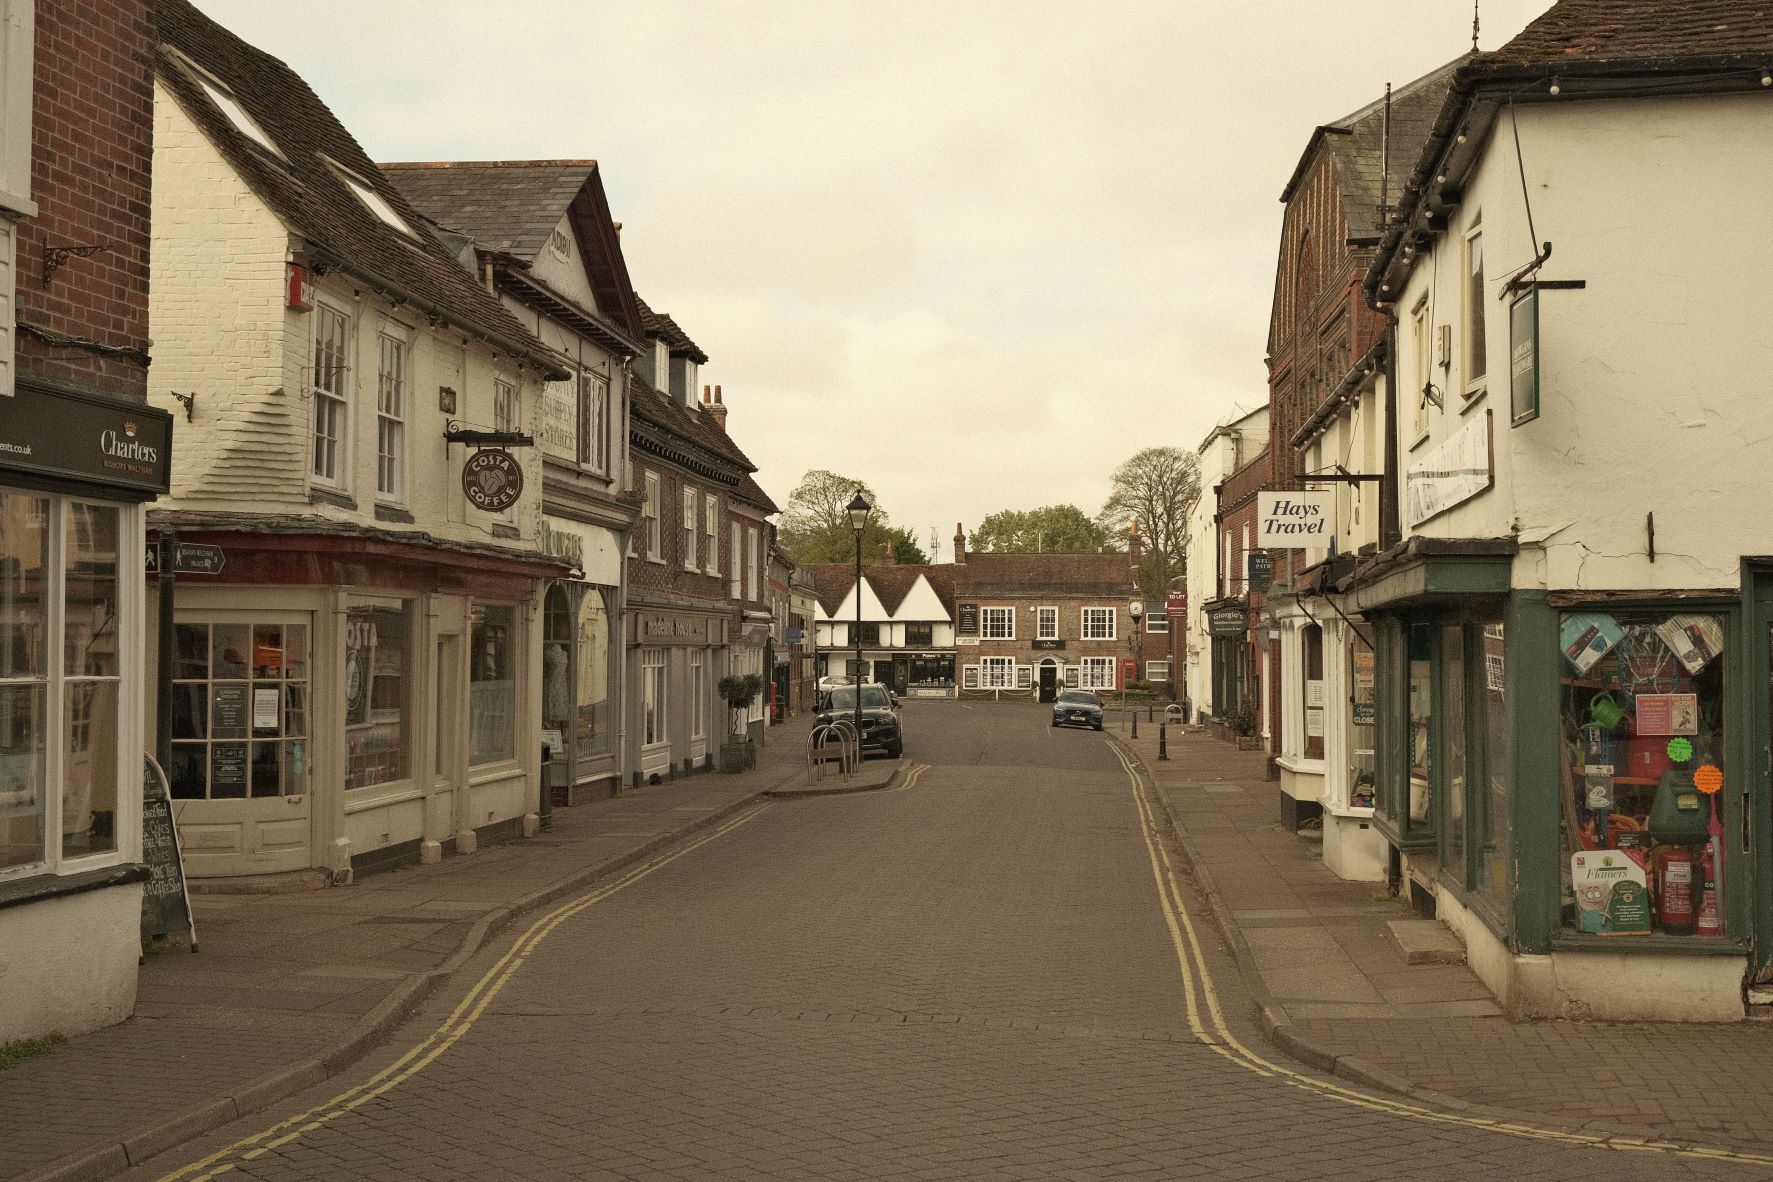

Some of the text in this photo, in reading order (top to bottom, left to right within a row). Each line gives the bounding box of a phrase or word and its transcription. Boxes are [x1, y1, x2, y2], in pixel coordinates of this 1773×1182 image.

[101, 429, 157, 463] Charters
[471, 454, 510, 471] COSTA
[470, 486, 515, 506] COFFEE
[1272, 500, 1320, 519] Hays
[1264, 518, 1325, 534] Travel
[1213, 611, 1243, 620] Giorgio's
[1586, 867, 1628, 880] Flamers
